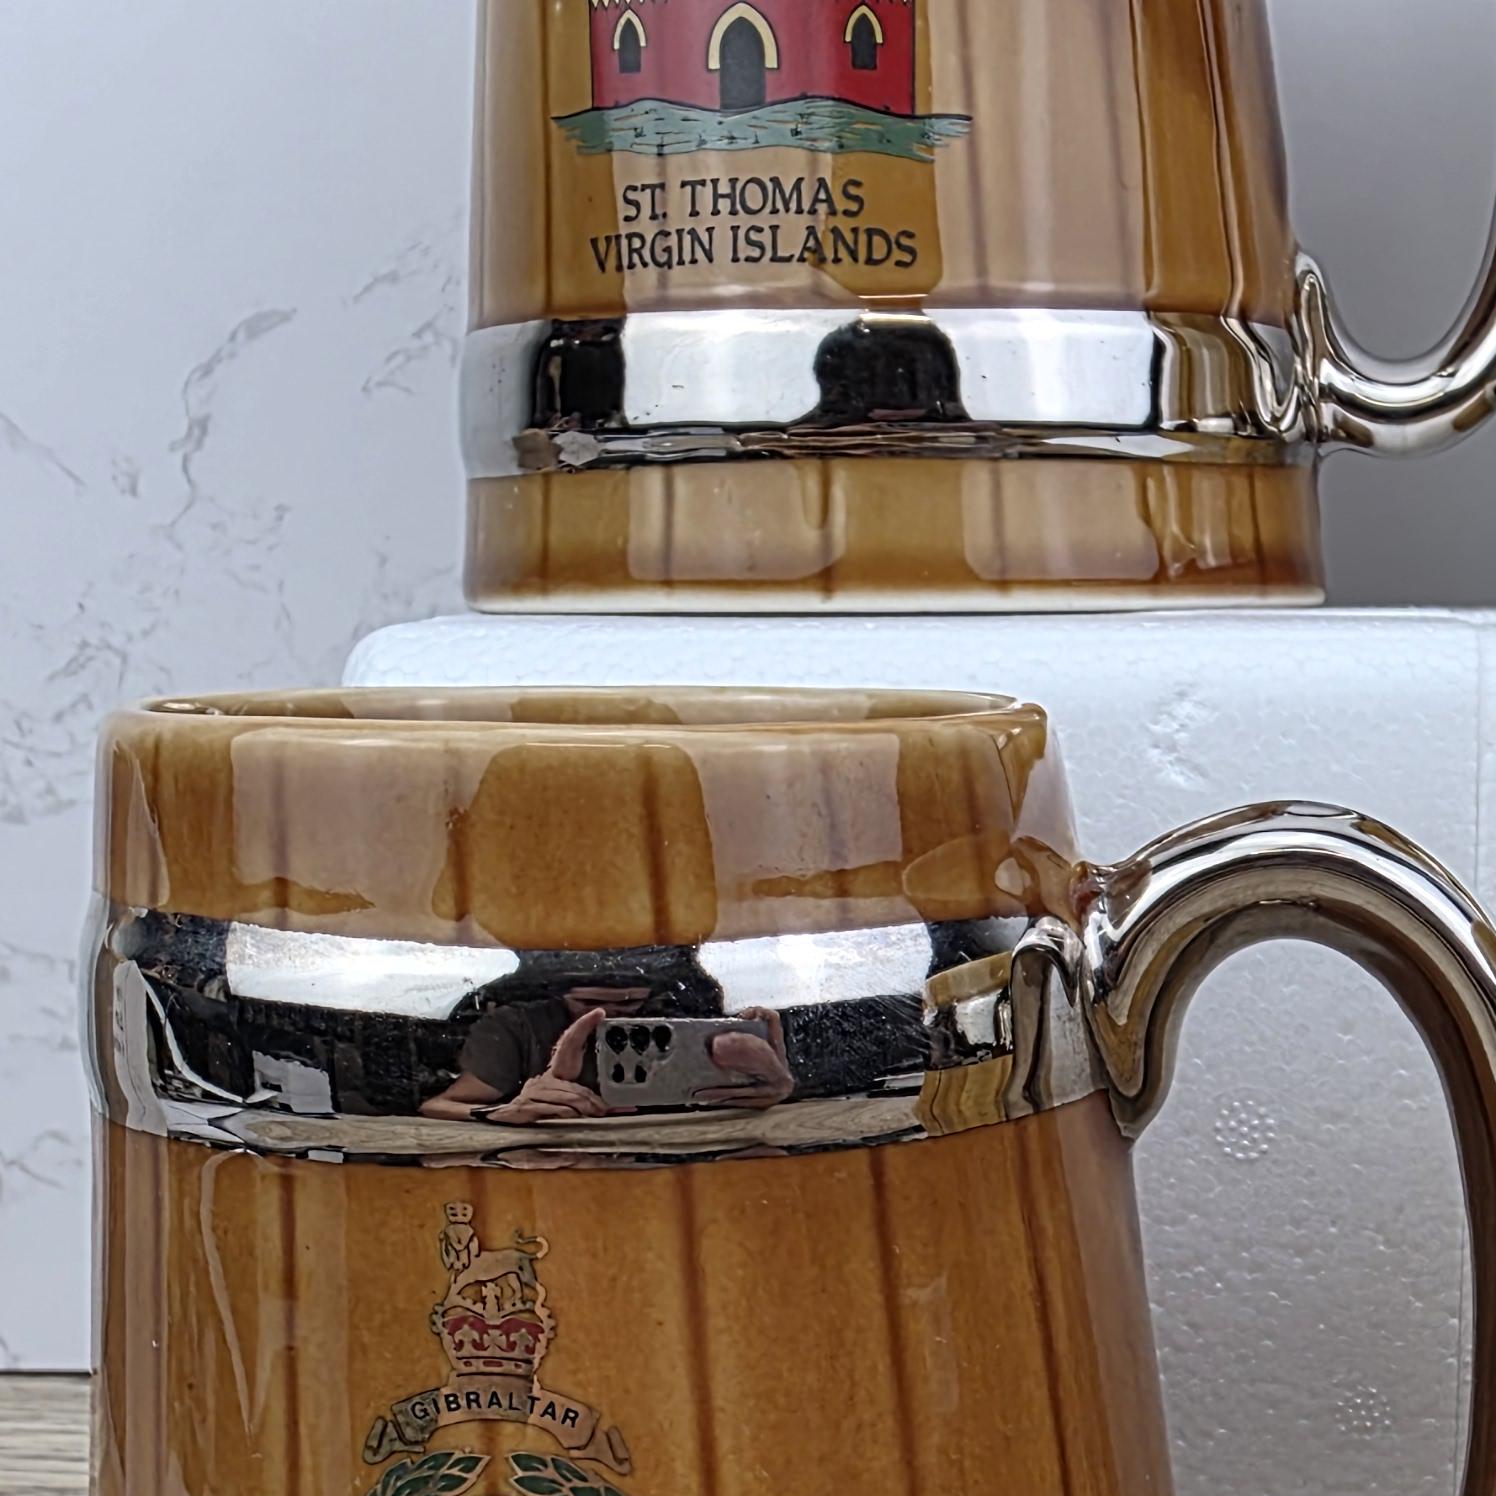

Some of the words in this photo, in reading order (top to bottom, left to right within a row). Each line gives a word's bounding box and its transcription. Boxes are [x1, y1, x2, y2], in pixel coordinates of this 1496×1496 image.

[622, 182, 668, 222] ST.
[680, 176, 866, 218] THOMAS
[590, 225, 716, 274] VIRGIN
[729, 224, 918, 269] ISLANDS
[410, 1390, 581, 1429] GIBRALTAR
